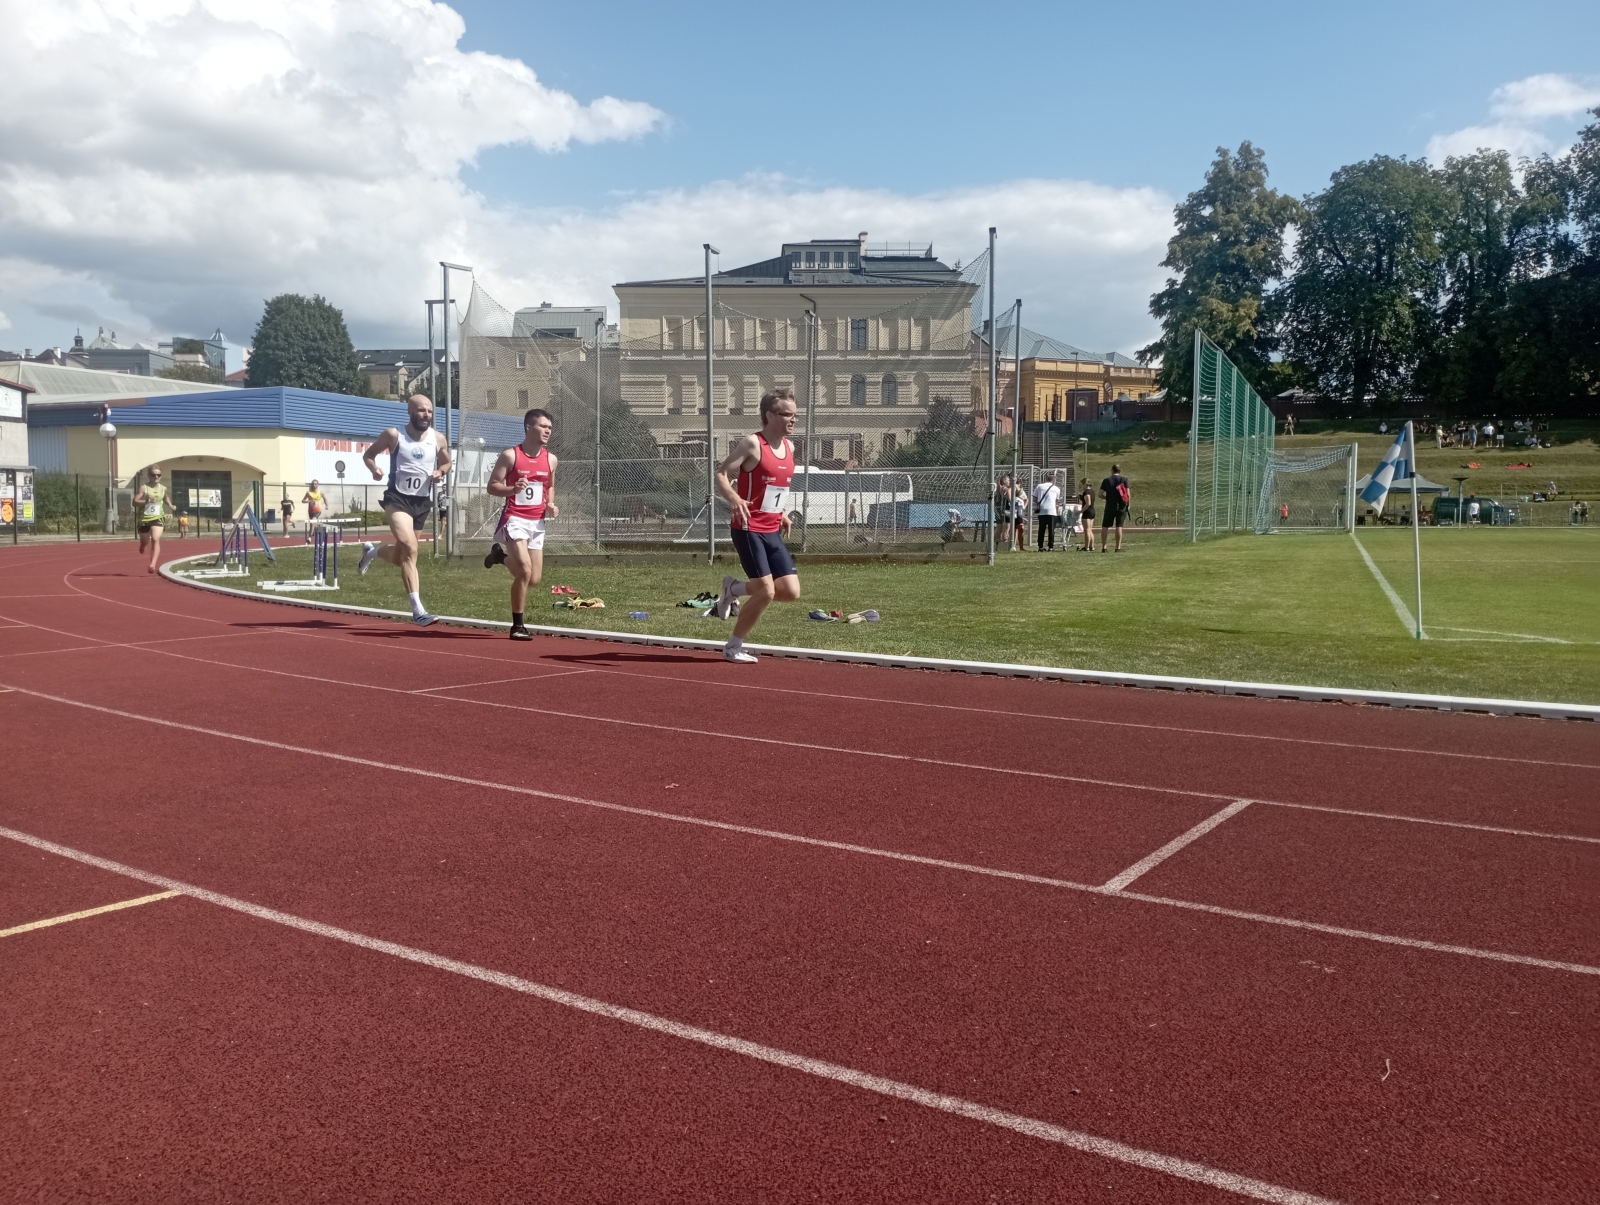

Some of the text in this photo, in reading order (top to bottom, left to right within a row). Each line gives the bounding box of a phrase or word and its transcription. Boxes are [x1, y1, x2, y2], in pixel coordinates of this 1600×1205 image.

[405, 477, 421, 489] 10
[525, 487, 534, 500] 9
[774, 493, 782, 507] 1
